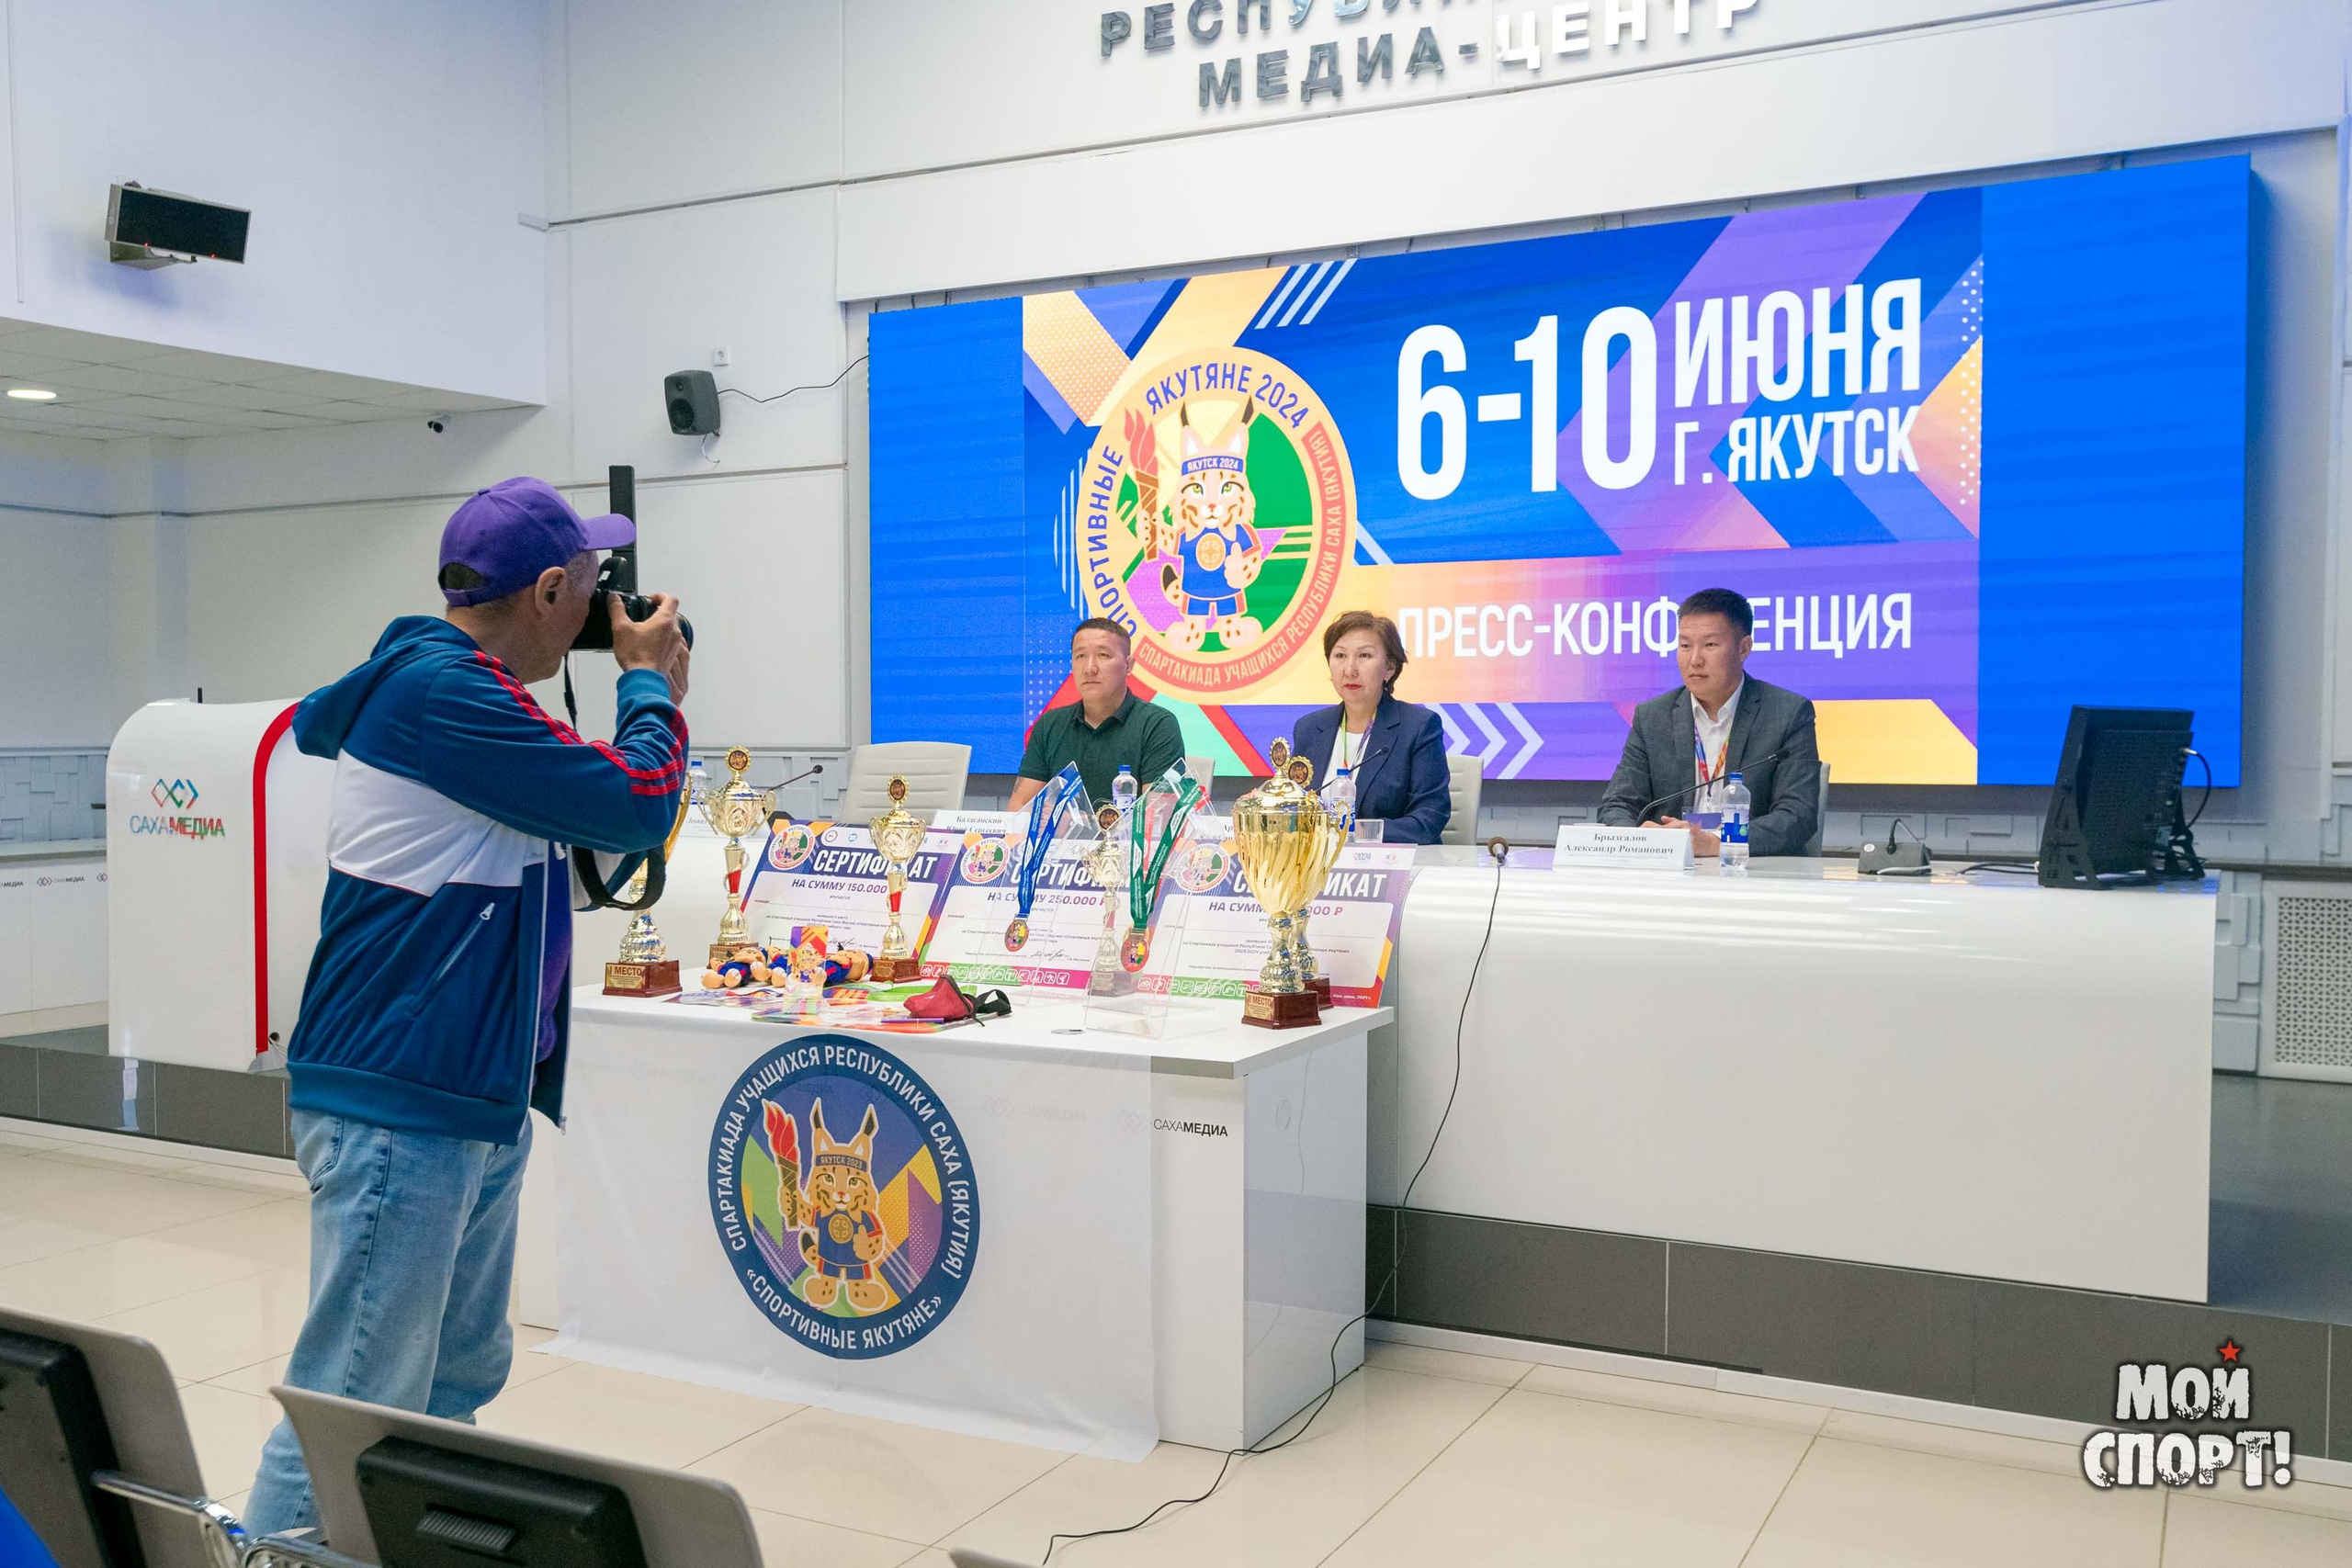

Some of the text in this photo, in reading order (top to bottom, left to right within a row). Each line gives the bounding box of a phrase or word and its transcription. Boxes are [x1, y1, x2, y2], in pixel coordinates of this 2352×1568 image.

[1145, 362, 1252, 414] ЯКУТЯНЕ
[1255, 373, 1310, 429] 2024
[1396, 277, 1922, 501] 6-10 ИЮНЯ
[1186, 457, 1239, 472] ЯКУТСК 2024
[1674, 405, 1920, 485] Г. ЯКУТСК
[1137, 430, 1341, 685] СПАРТАКИАДА УЧАЩИХСЯ РЕСПУБЛИКИ САХА (ЯКУТИЯ)
[1397, 594, 1913, 659] ПРЕСС-КОНФЕНЦИЯ
[791, 878, 888, 894] НА СУММУ 150.000
[1208, 901, 1226, 911] НА
[614, 965, 642, 976] МЕСТО
[1153, 1118, 1228, 1137] САХАМЕДИА
[715, 1044, 970, 1280] СПАРТАКИАДА УЧАЩИХСЯ РЕСПУБЛИКИ САХА (ЯКУТИЯ)
[820, 1156, 864, 1168] ЯКУТСК 2023
[746, 1268, 943, 1349] «СПОРТИВНЫЕ ЯКУТЯНЕ»
